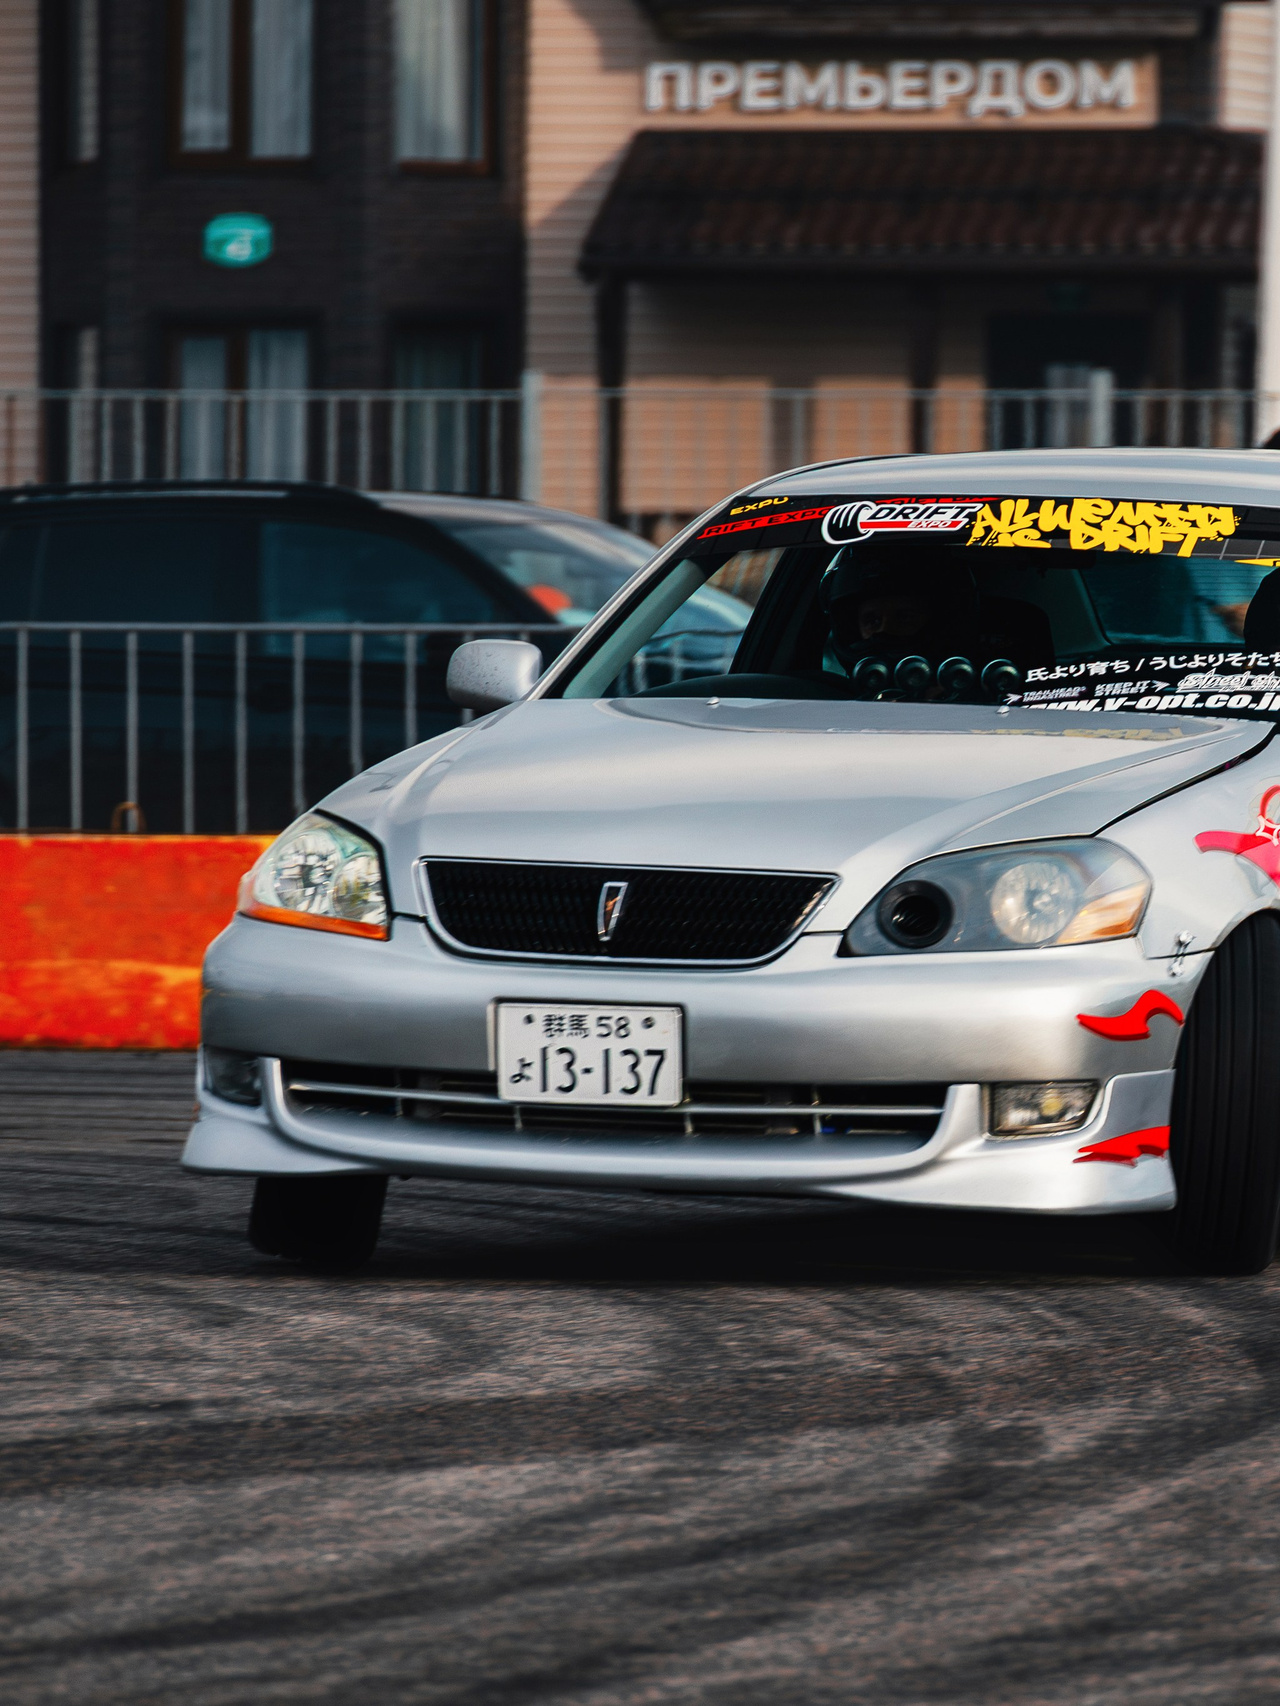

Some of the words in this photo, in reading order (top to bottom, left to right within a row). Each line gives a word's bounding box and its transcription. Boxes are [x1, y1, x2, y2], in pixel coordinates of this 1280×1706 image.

[644, 59, 1137, 117] ПРЕМЬЕРДОМ
[867, 505, 980, 520] DRIFT
[703, 518, 763, 536] RIFT
[907, 520, 952, 529] EXPO
[1025, 660, 1131, 683] 氏より育ち
[1094, 686, 1148, 697] STREET
[1096, 681, 1134, 691] KEEP
[542, 1013, 590, 1039] 群馬
[596, 1015, 631, 1039] 58
[509, 1057, 535, 1085] よ
[539, 1045, 668, 1097] 13-137
